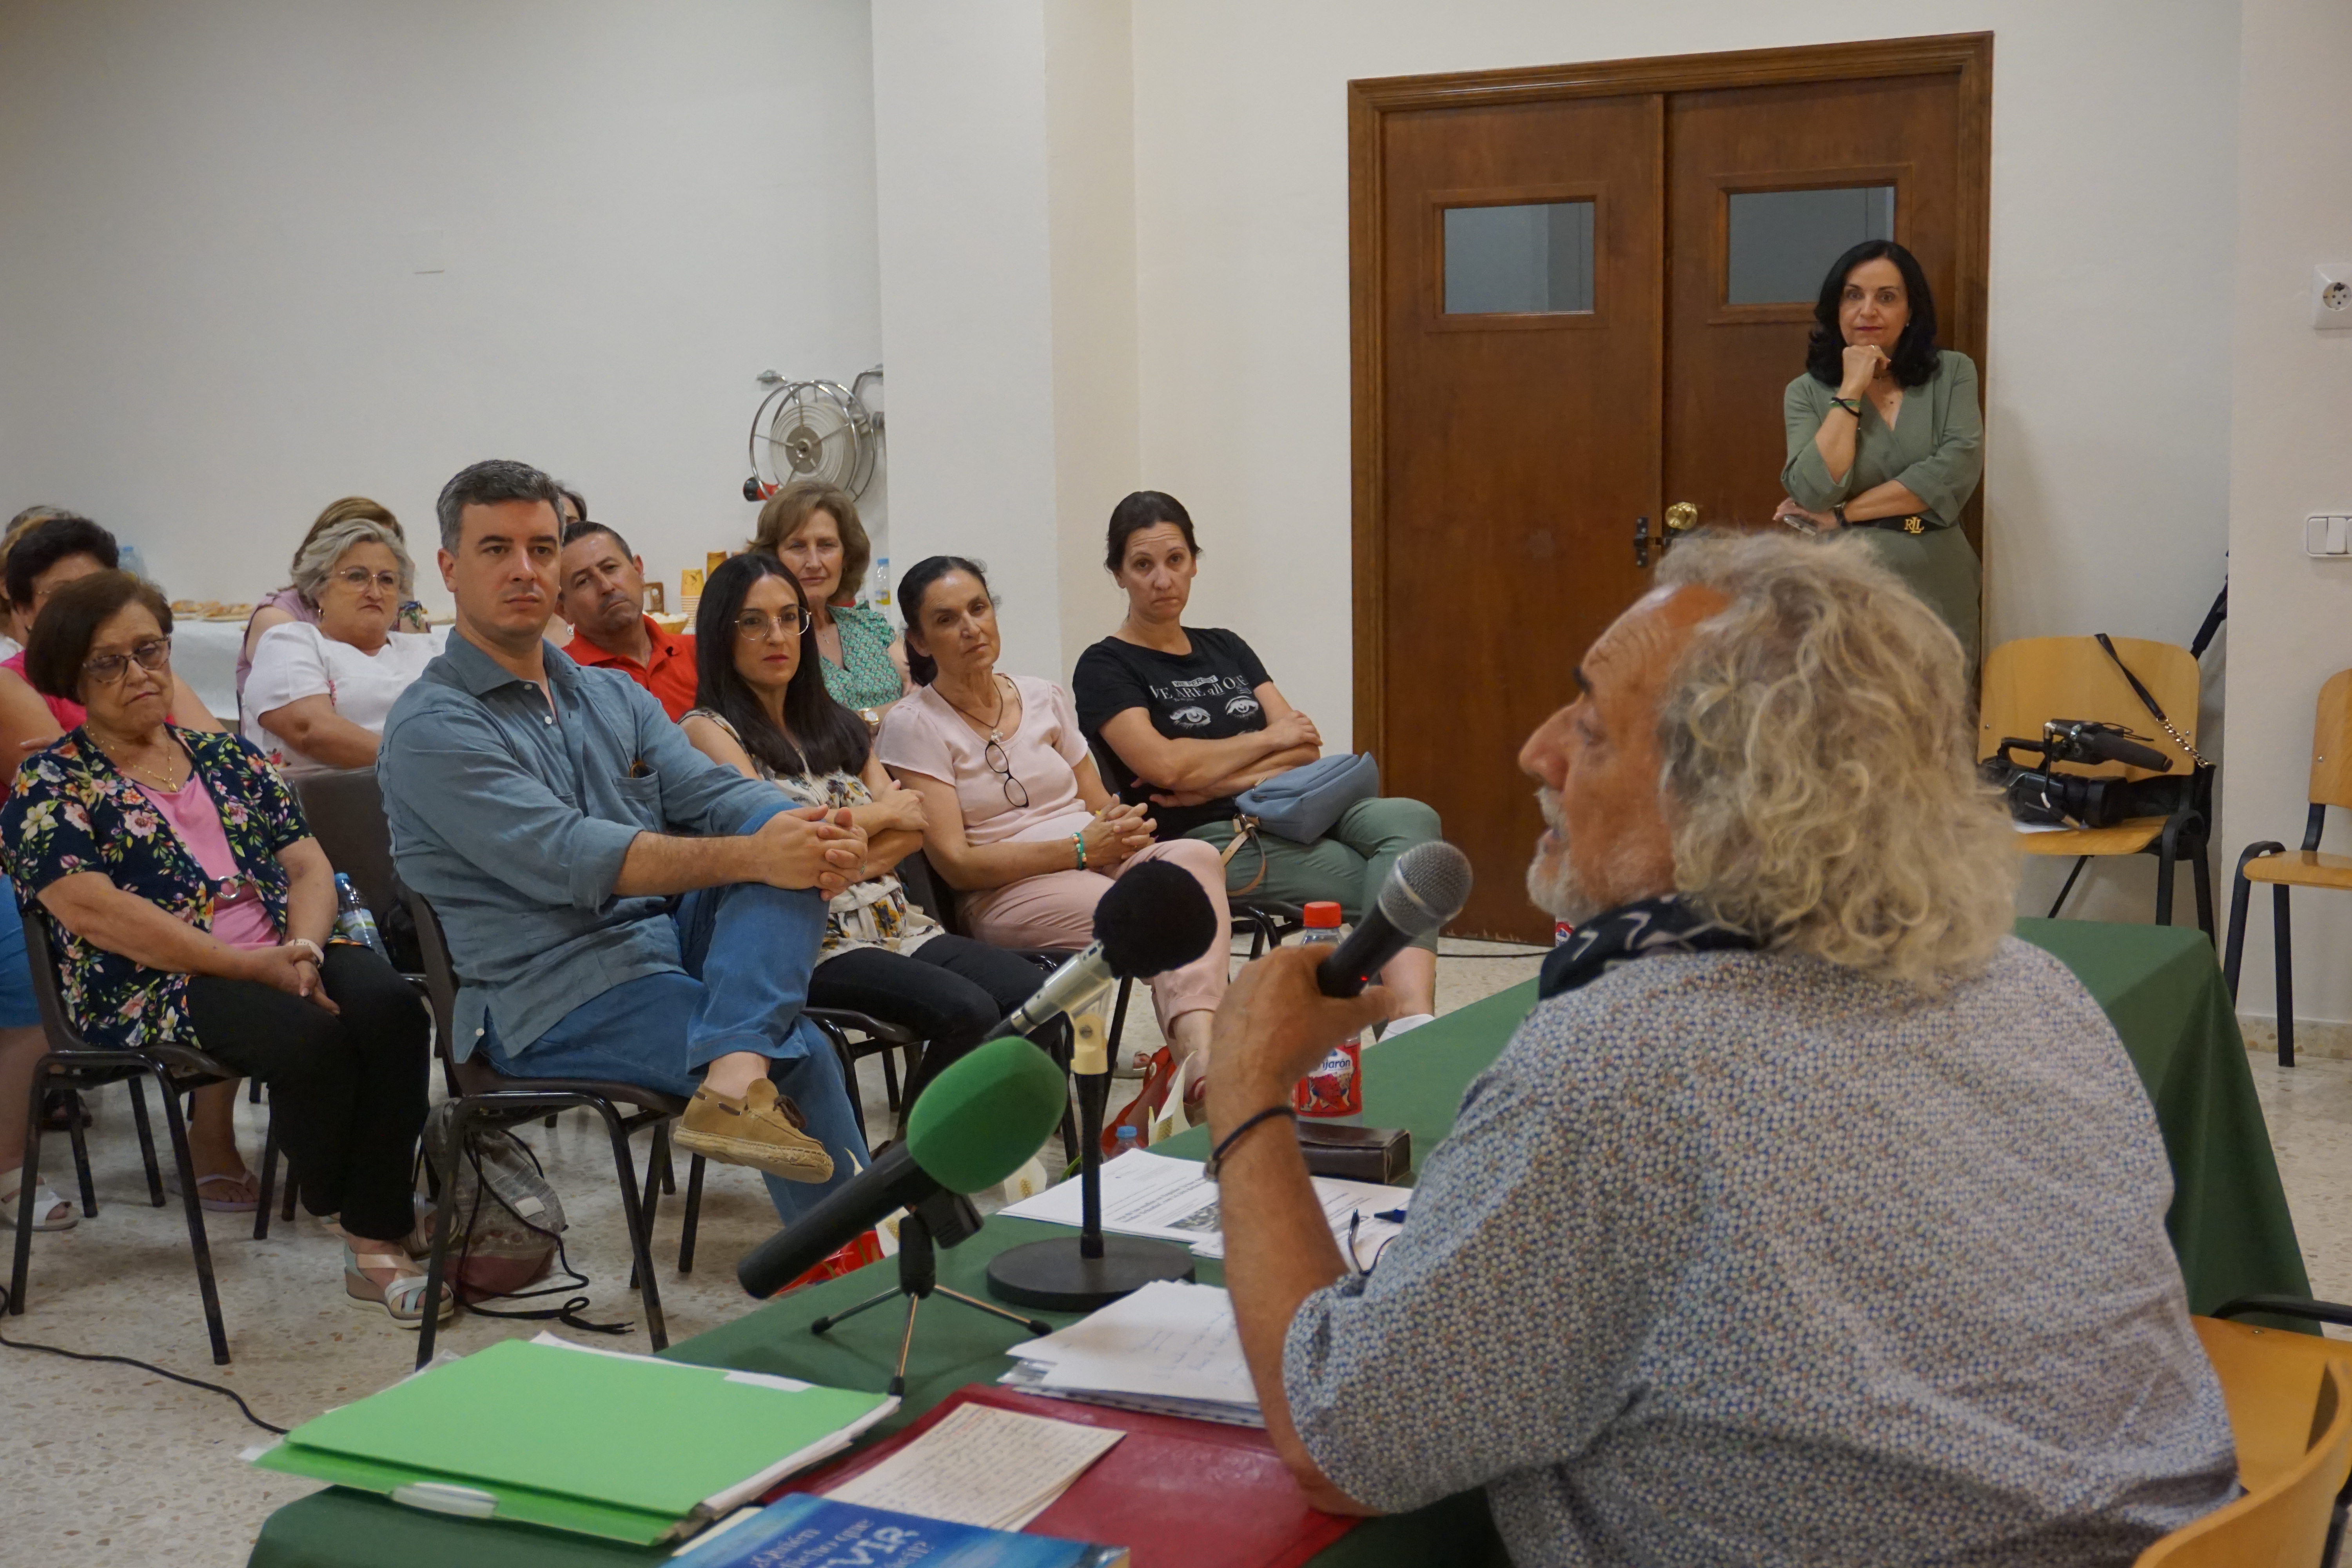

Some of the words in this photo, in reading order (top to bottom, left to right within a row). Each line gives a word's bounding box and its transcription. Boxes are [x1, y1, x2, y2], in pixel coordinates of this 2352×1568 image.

[1175, 687, 1206, 698] ARE
[1207, 682, 1223, 695] all
[1223, 675, 1249, 689] OE
